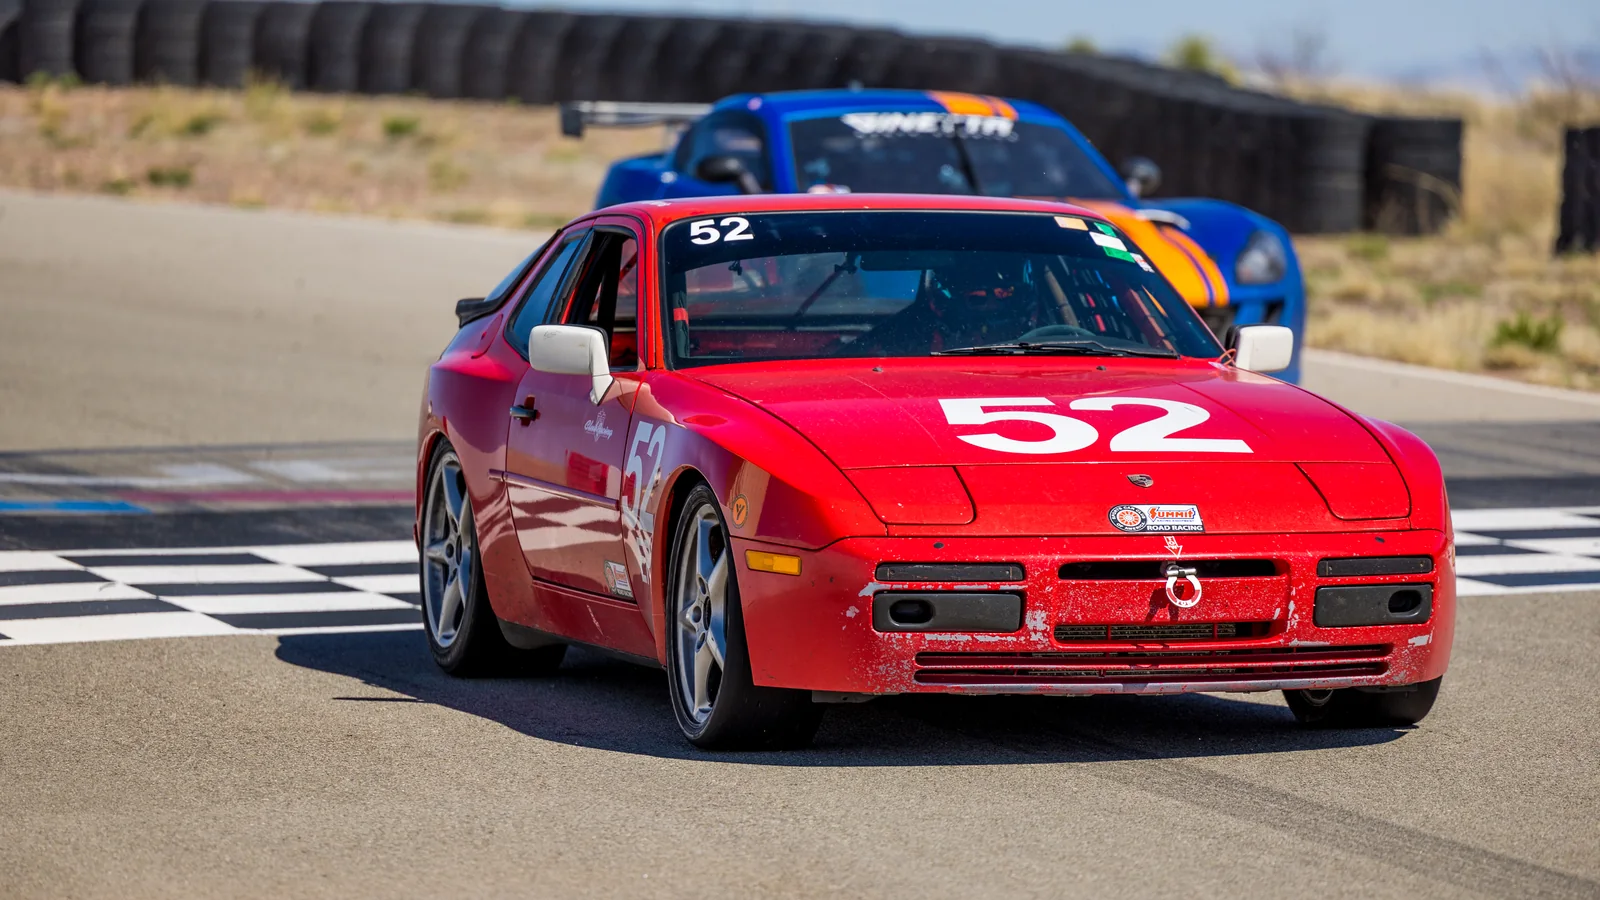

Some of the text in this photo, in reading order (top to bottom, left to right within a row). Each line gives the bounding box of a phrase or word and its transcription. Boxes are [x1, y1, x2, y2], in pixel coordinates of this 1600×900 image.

[689, 216, 755, 245] 52
[937, 397, 1254, 454] 52
[621, 420, 666, 533] 52
